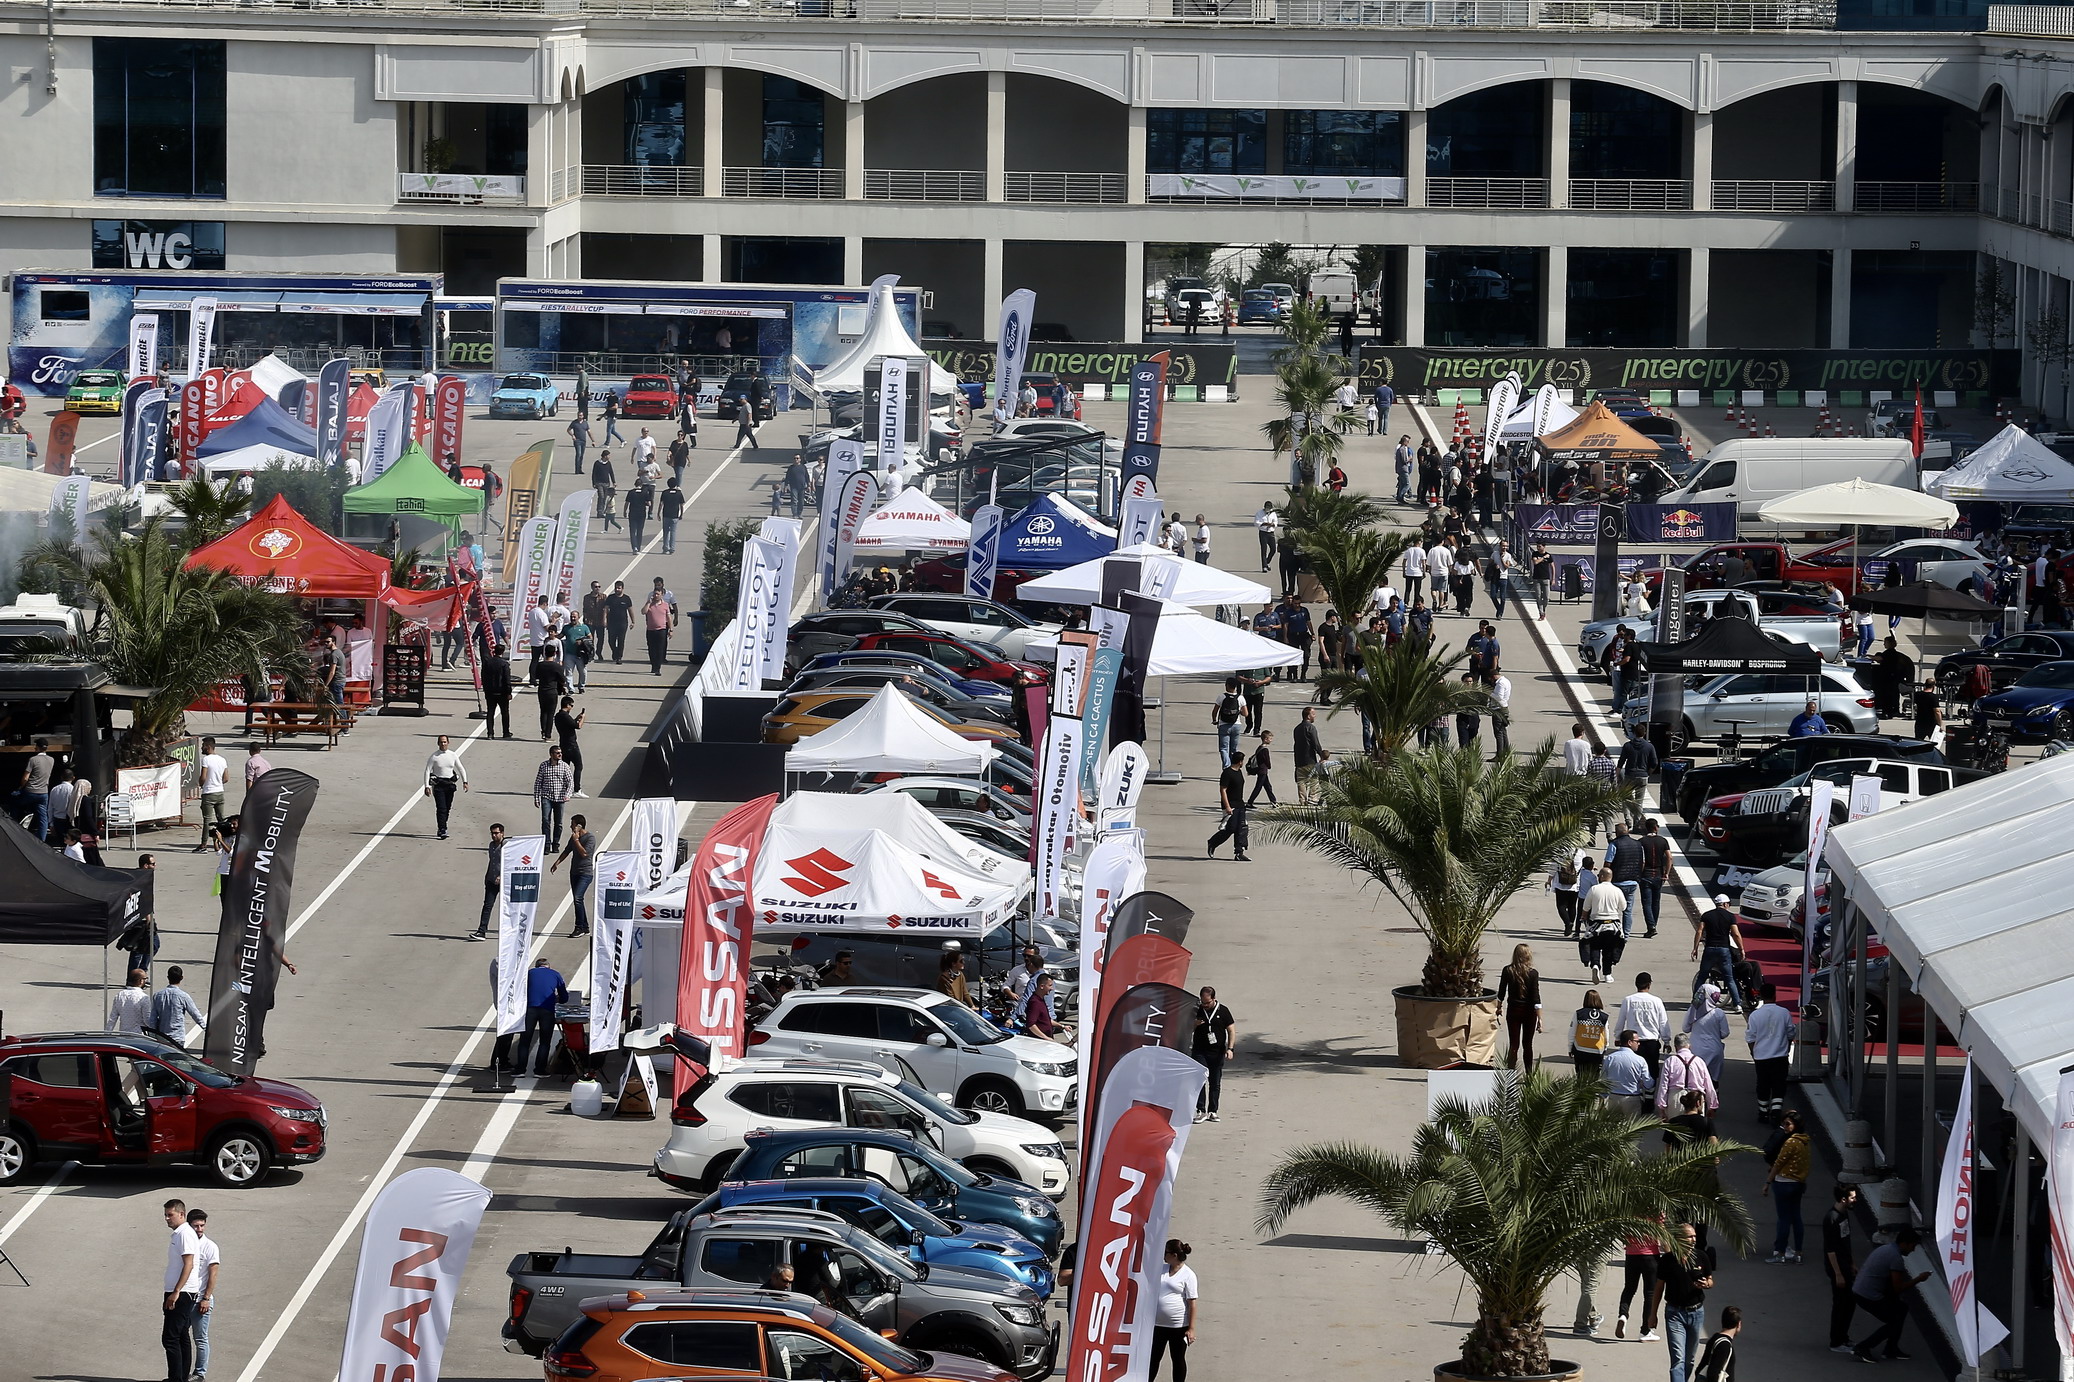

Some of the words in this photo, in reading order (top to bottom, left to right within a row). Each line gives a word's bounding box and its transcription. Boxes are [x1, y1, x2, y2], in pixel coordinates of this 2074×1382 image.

[126, 233, 192, 269] WC
[1004, 318, 1019, 352] Ford
[964, 353, 989, 373] 25
[1358, 359, 1384, 379] 25
[1555, 360, 1580, 381] 25
[1753, 360, 1779, 382] 25
[1953, 361, 1978, 382] 25
[1001, 365, 1012, 399] Further
[327, 381, 340, 441] BAJAJ
[884, 383, 899, 454] HYUNDAI
[1136, 387, 1150, 442] HYUND
[1487, 384, 1510, 449] BRIDGESTONE
[1537, 387, 1553, 437] IDGESTONE
[440, 386, 460, 474] ALCANO
[144, 421, 158, 481] BAJAJ
[373, 428, 387, 479] uralkan
[460, 477, 485, 488] LCAN
[842, 479, 870, 528] YAMAHA
[890, 511, 941, 523] YAMAHA
[854, 537, 882, 545] AMAHA
[937, 539, 969, 548] YAMAHA
[1017, 536, 1063, 545] YAMAHA
[1661, 526, 1683, 539] Red
[1683, 525, 1704, 538] Bull
[1928, 528, 1950, 539] Red
[1951, 528, 1972, 539] Bull
[738, 556, 766, 687] PEUGEOT
[1091, 677, 1105, 721] CACTUS
[1088, 723, 1098, 739] C4
[1050, 732, 1072, 805] Otomotiv
[1116, 755, 1136, 806] ZUKI
[254, 784, 294, 874] MOBILITY
[649, 832, 663, 890] AGGIO
[1717, 865, 1753, 888] Jee
[608, 901, 618, 909] Way
[759, 897, 858, 911] SUZUKI
[781, 911, 845, 925] SUZUKI
[239, 876, 268, 995] INTELLIGENT
[905, 916, 969, 928] SUZUKI
[698, 842, 750, 1048] ISSAN
[231, 1000, 248, 1065] NISSAN
[1585, 1026, 1600, 1035] 112
[540, 1286, 565, 1294] 4WD
[1083, 1165, 1147, 1382] SSAN
